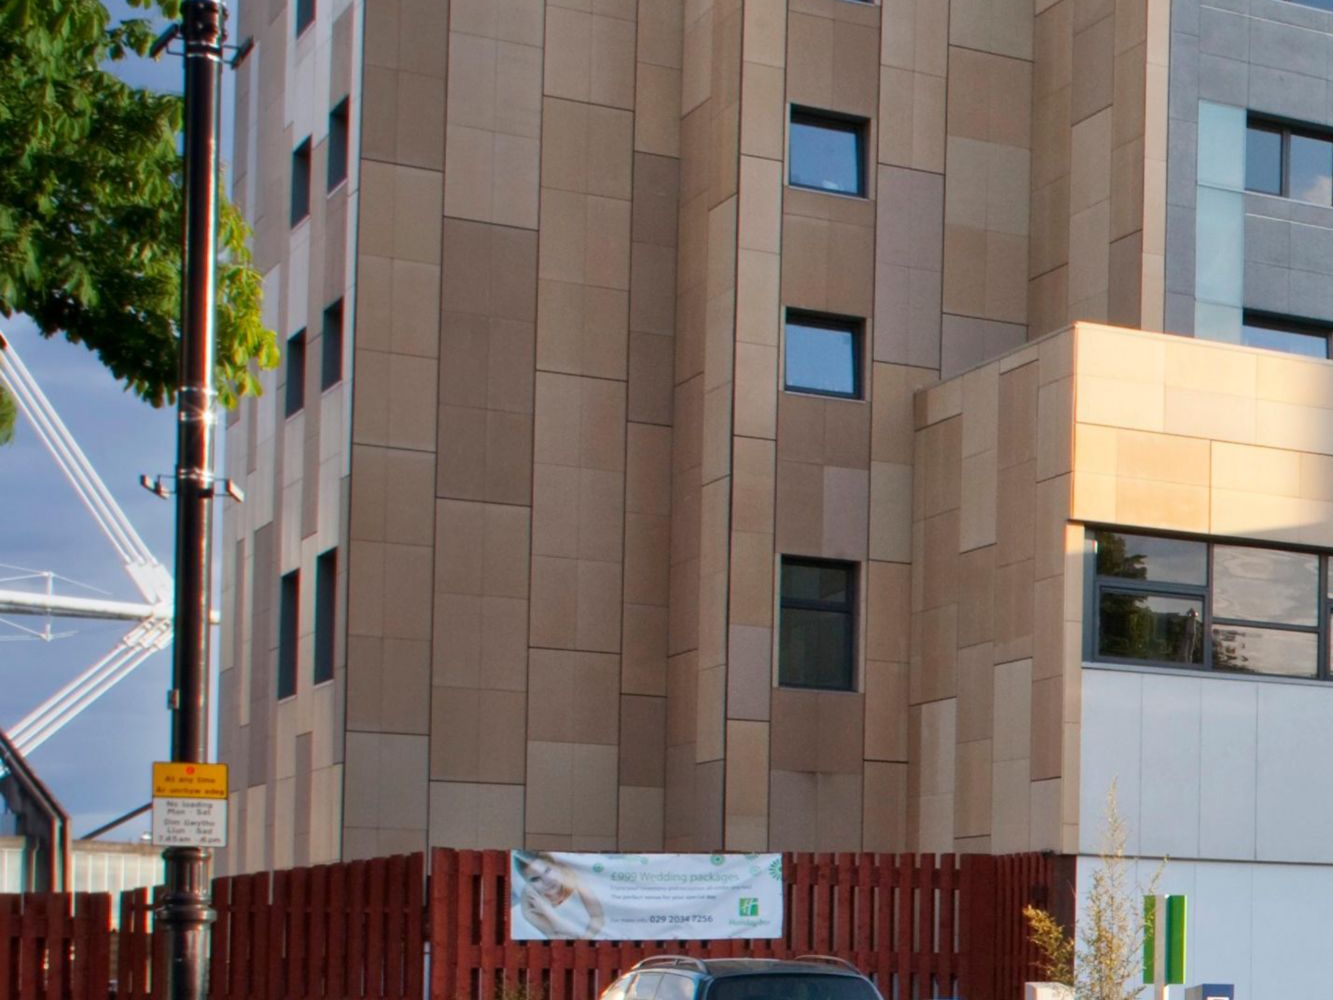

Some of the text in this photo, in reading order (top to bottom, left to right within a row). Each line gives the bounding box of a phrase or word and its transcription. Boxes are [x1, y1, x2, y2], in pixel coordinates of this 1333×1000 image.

[611, 871, 739, 884] £999 Wedding packages
[650, 915, 667, 923] 029
[692, 915, 714, 923] 7256
